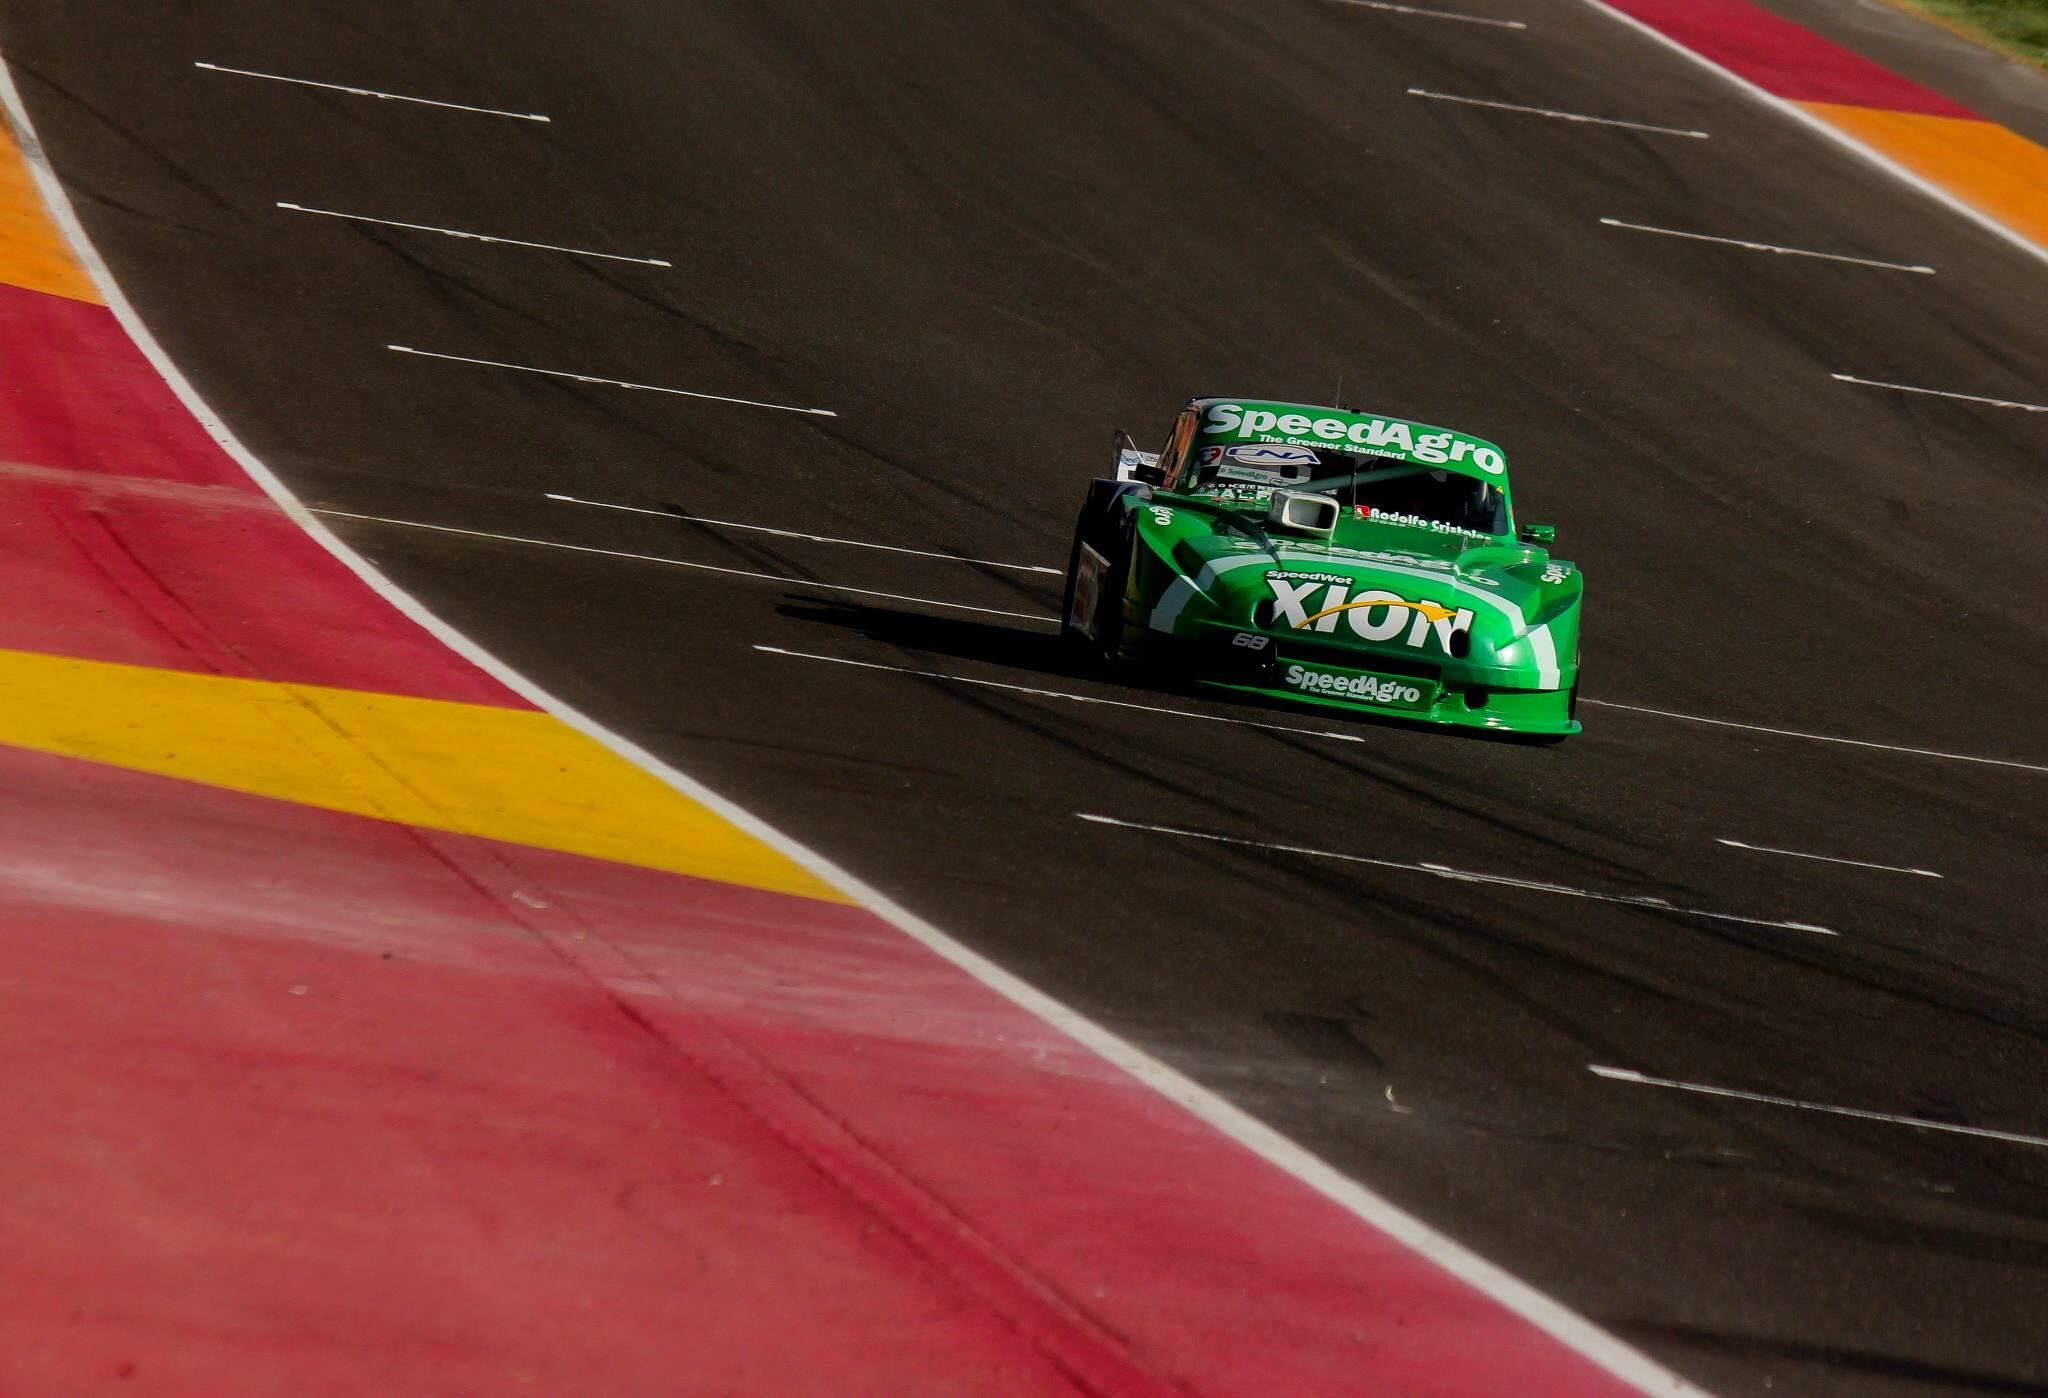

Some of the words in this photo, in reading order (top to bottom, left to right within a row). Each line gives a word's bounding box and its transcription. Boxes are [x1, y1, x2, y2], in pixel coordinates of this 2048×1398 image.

[1202, 404, 1505, 475] SpeedAgro
[1259, 434, 1284, 444] The
[1286, 437, 1342, 451] Greener
[1344, 444, 1407, 461] Standard
[1370, 508, 1428, 527] Rodolfo
[1266, 570, 1353, 585] SpeedWet
[1267, 579, 1474, 656] XION
[1231, 633, 1270, 650] 68
[1285, 665, 1421, 703] SpeedAgro
[1320, 688, 1346, 697] Greener
[1346, 691, 1374, 701] Standard
